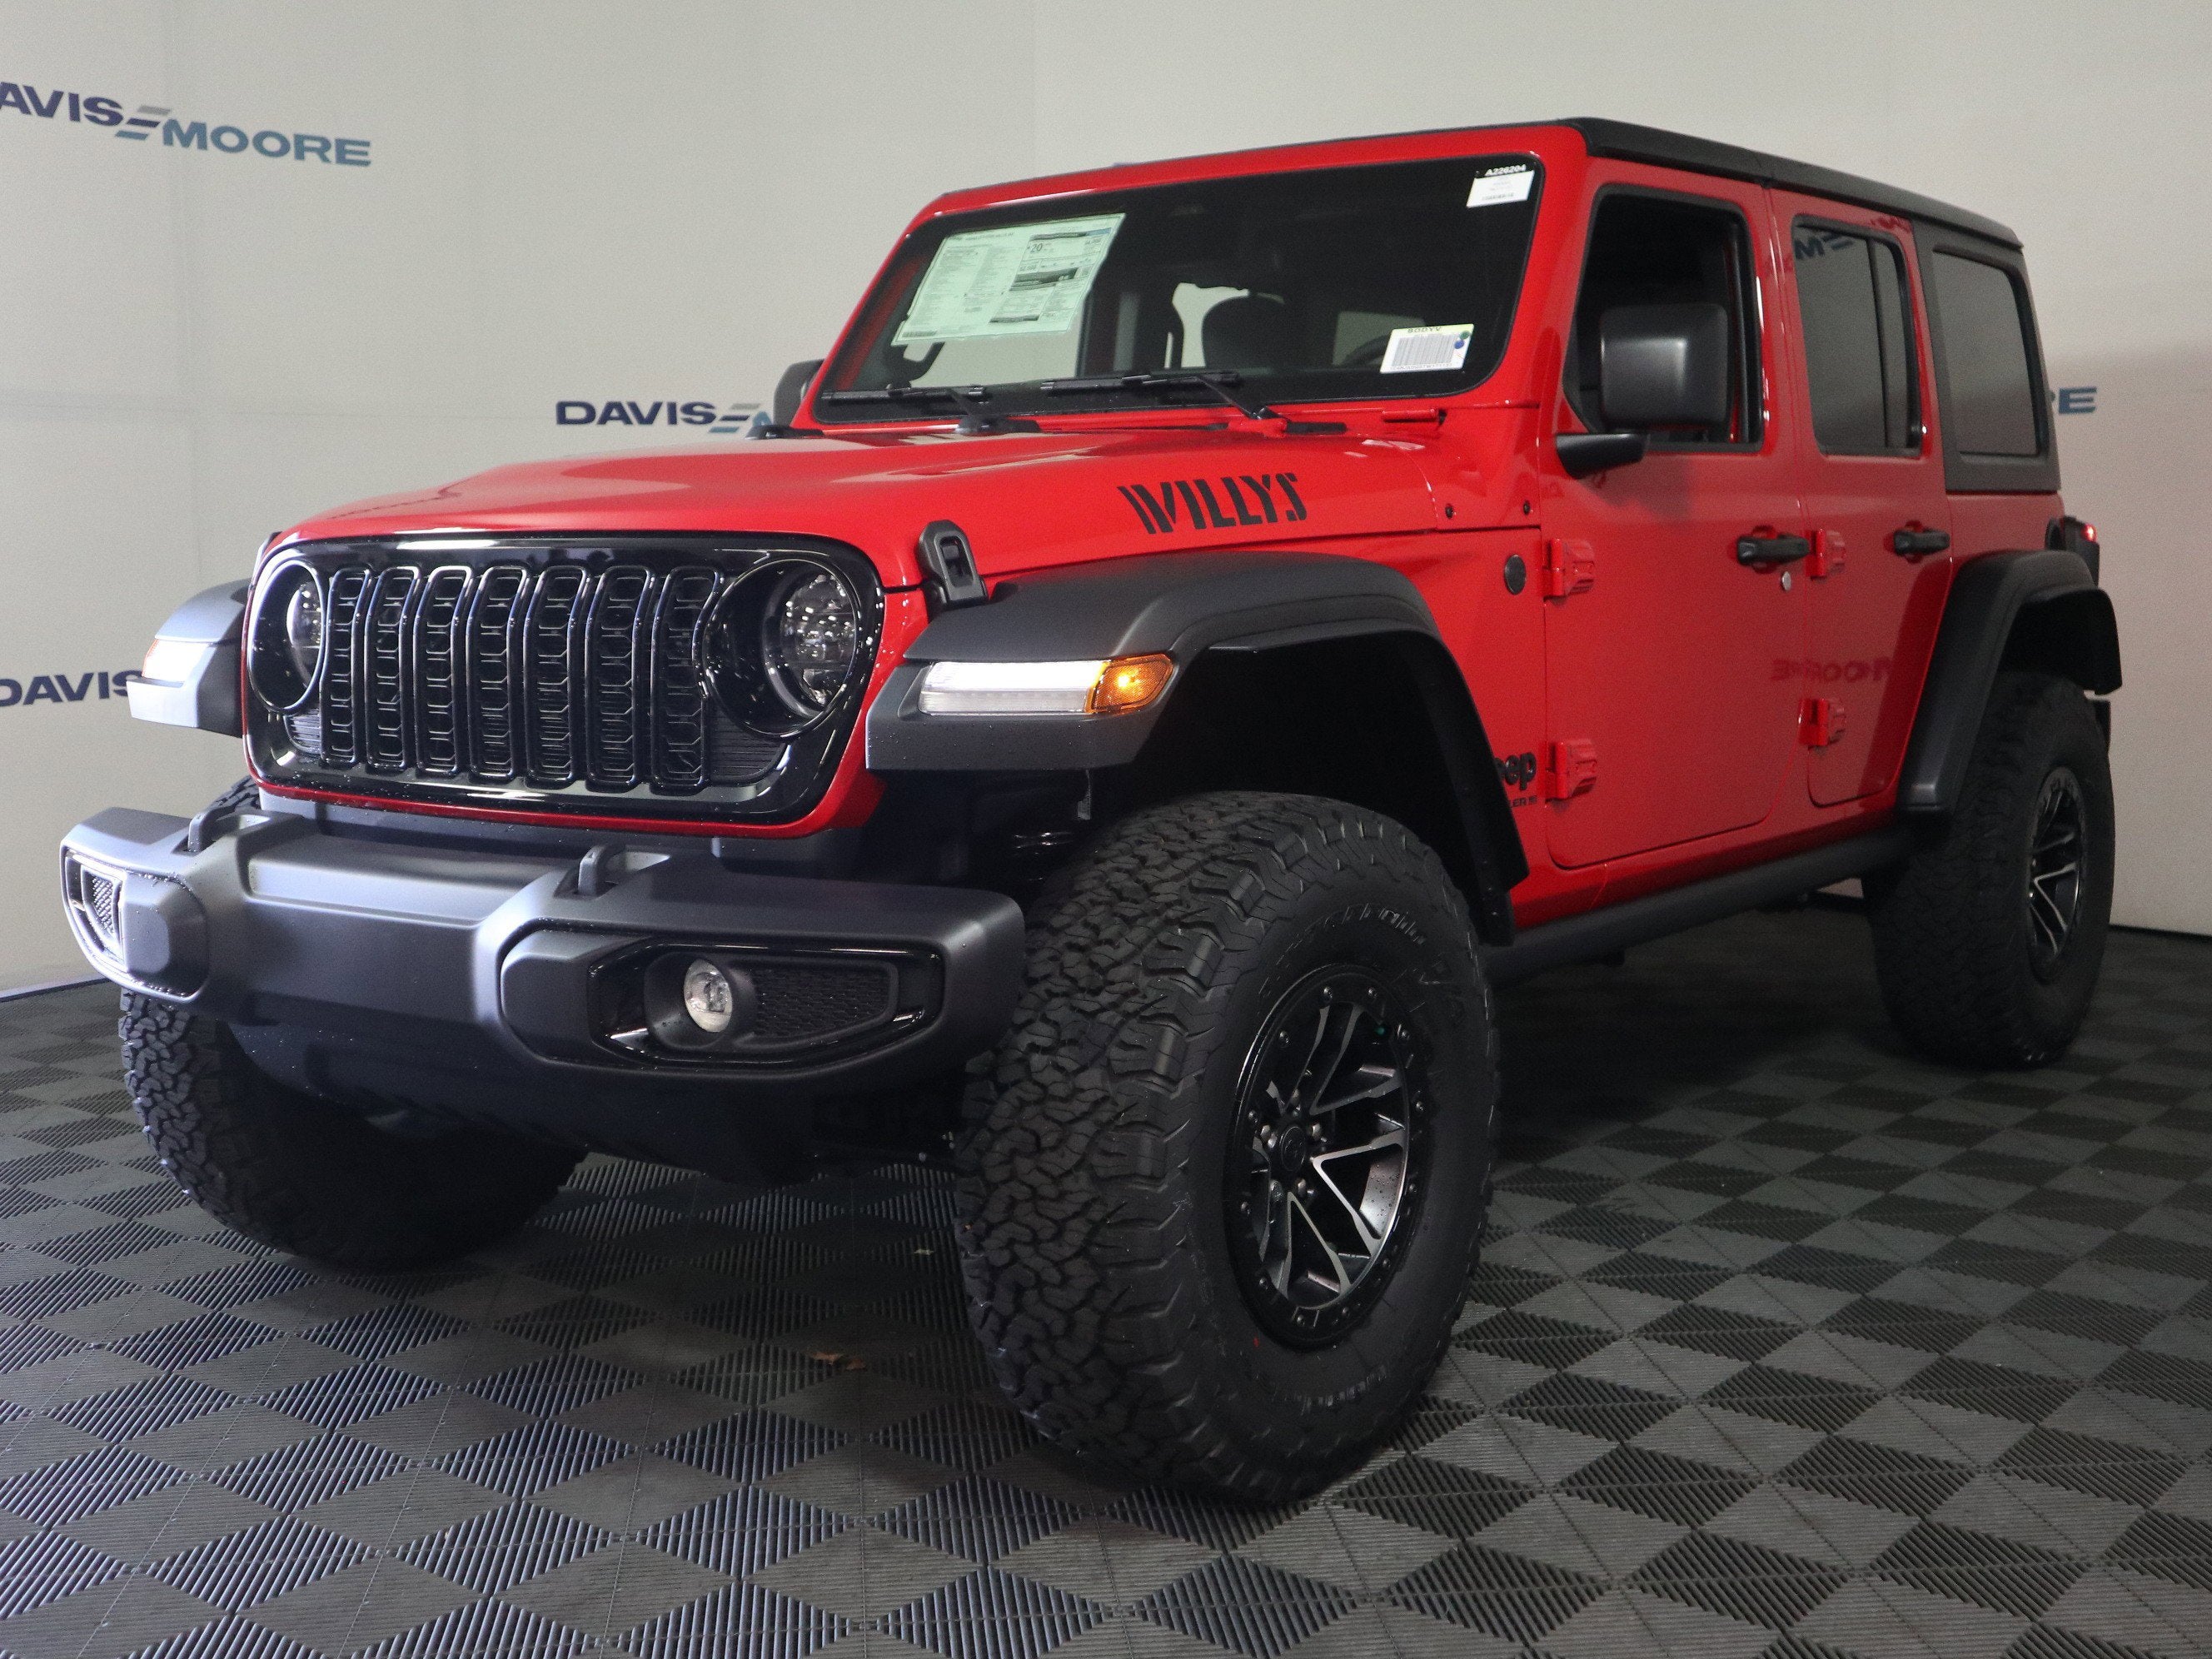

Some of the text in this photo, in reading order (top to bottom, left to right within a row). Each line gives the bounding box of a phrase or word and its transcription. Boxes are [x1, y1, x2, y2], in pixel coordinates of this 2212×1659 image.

[0, 82, 371, 167] AVIS MOORE
[555, 401, 717, 426] DAVIS
[1116, 472, 1308, 535] WILLYS
[1496, 752, 1537, 790] ep
